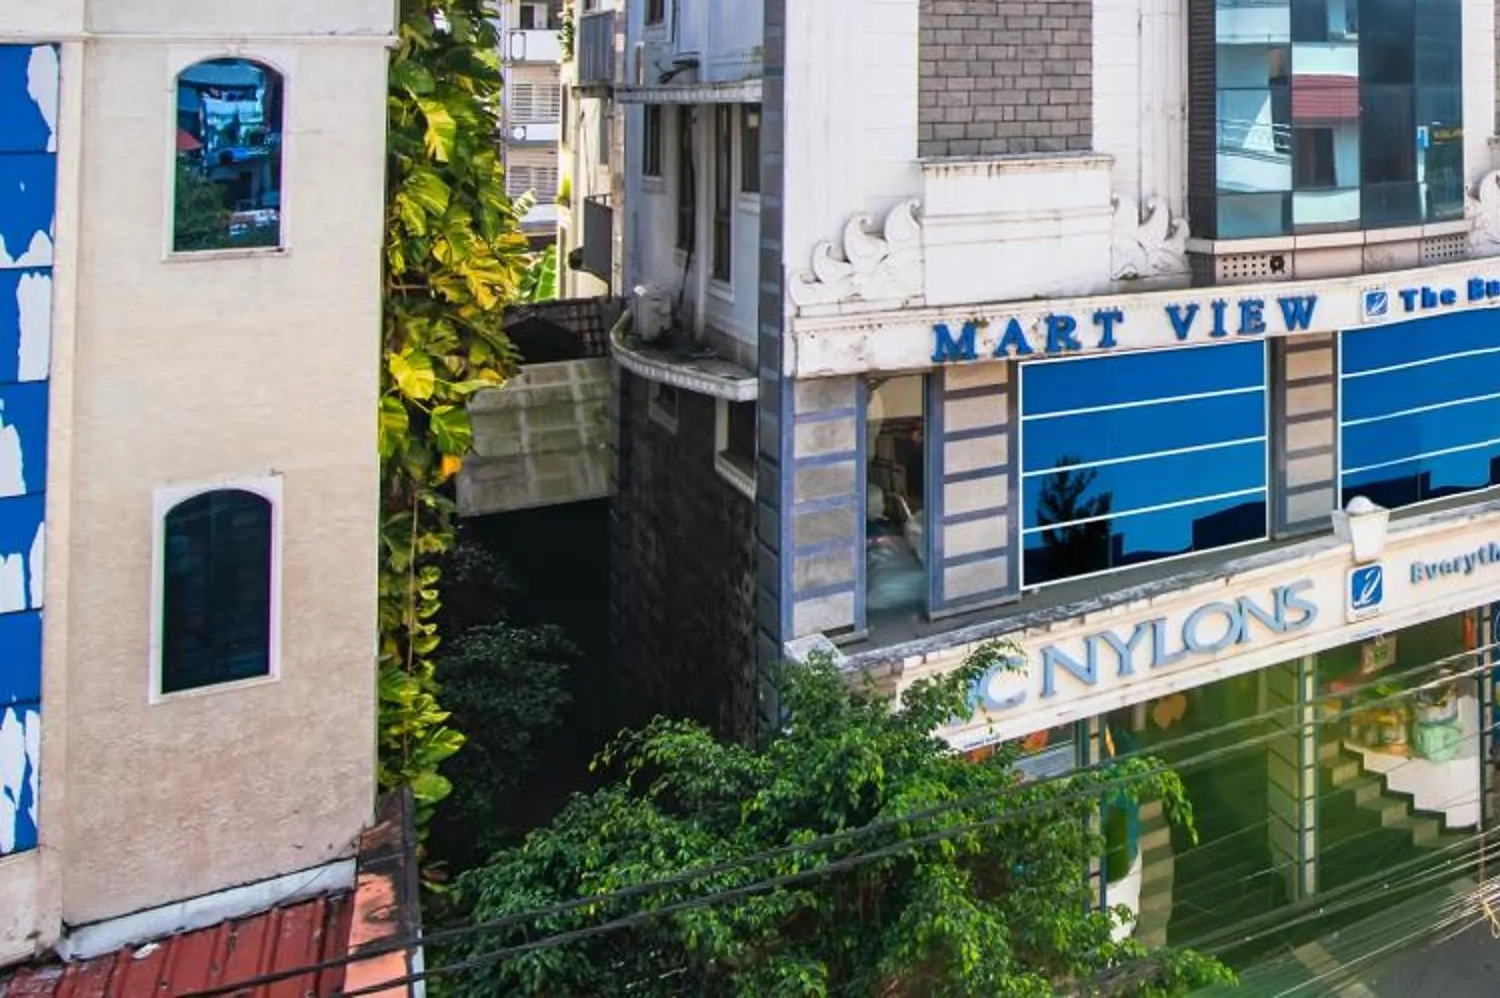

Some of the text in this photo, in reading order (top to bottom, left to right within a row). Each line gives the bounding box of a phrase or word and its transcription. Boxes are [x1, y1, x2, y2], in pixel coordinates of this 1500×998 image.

[932, 293, 1318, 364] MART VIEW
[1399, 287, 1457, 313] The
[1039, 578, 1319, 700] NYLONS
